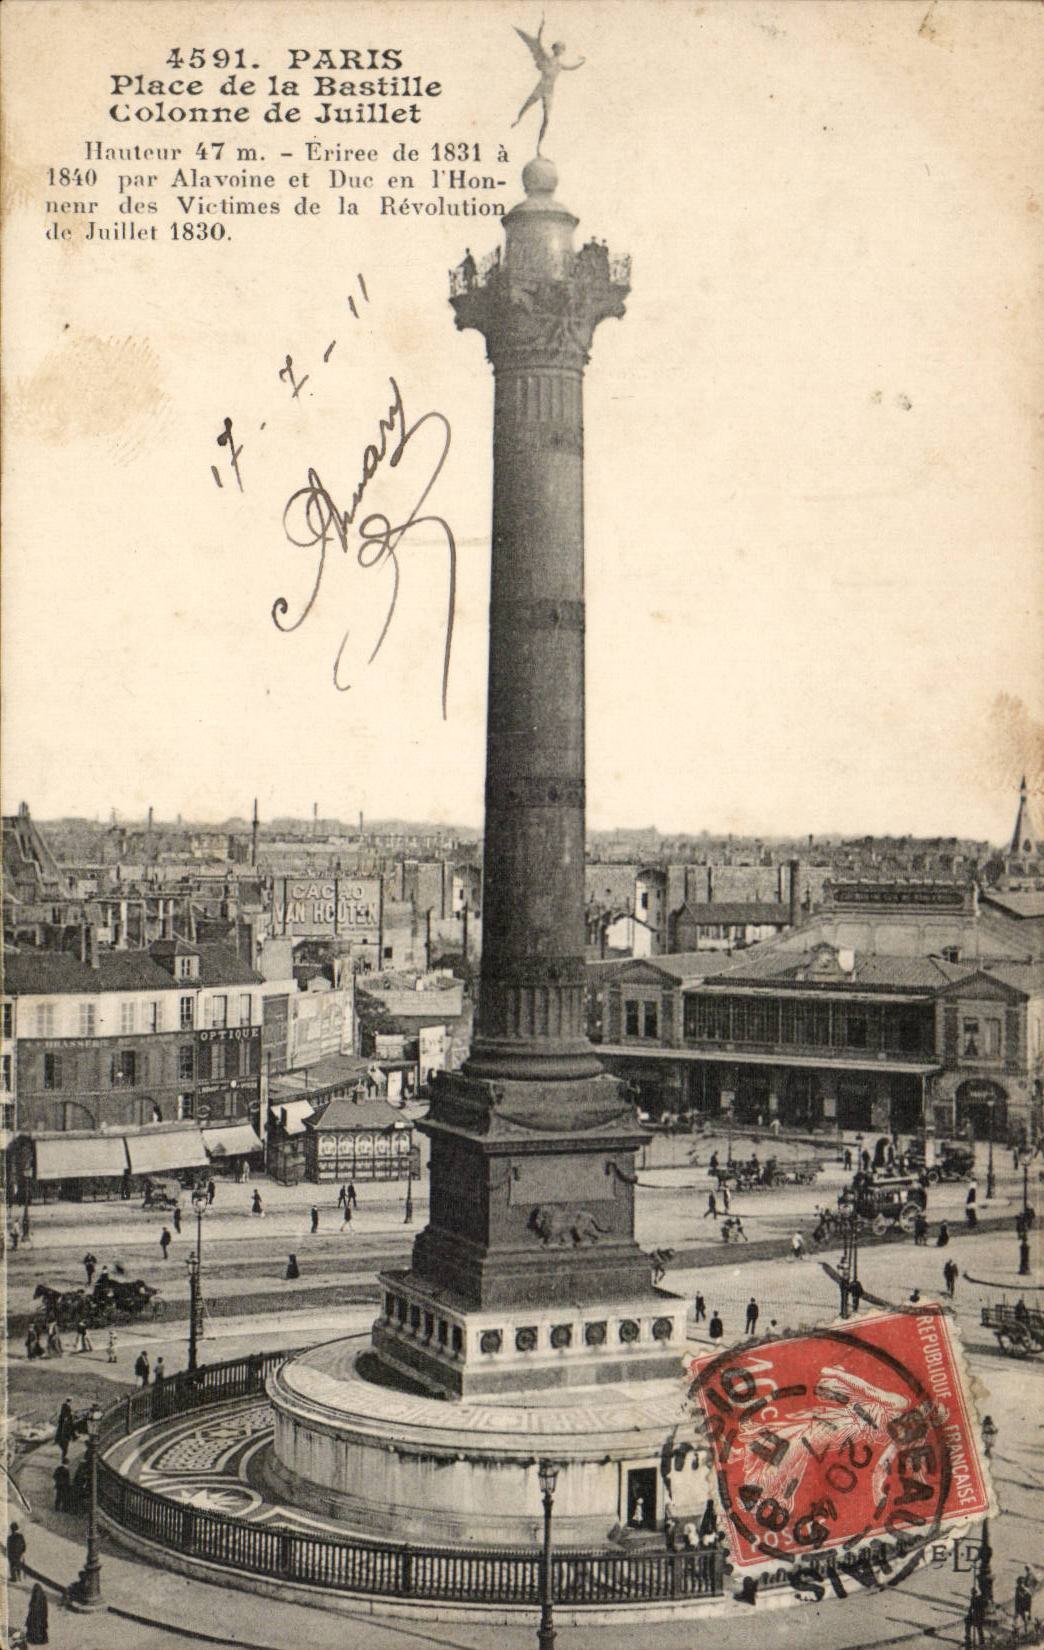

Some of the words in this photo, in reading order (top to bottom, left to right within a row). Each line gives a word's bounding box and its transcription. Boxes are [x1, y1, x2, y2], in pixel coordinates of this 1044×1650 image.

[292, 884, 366, 901] CACAO
[274, 901, 306, 924] VAN
[312, 900, 377, 925] HOUTEN
[200, 1026, 260, 1043] OPTIQUE
